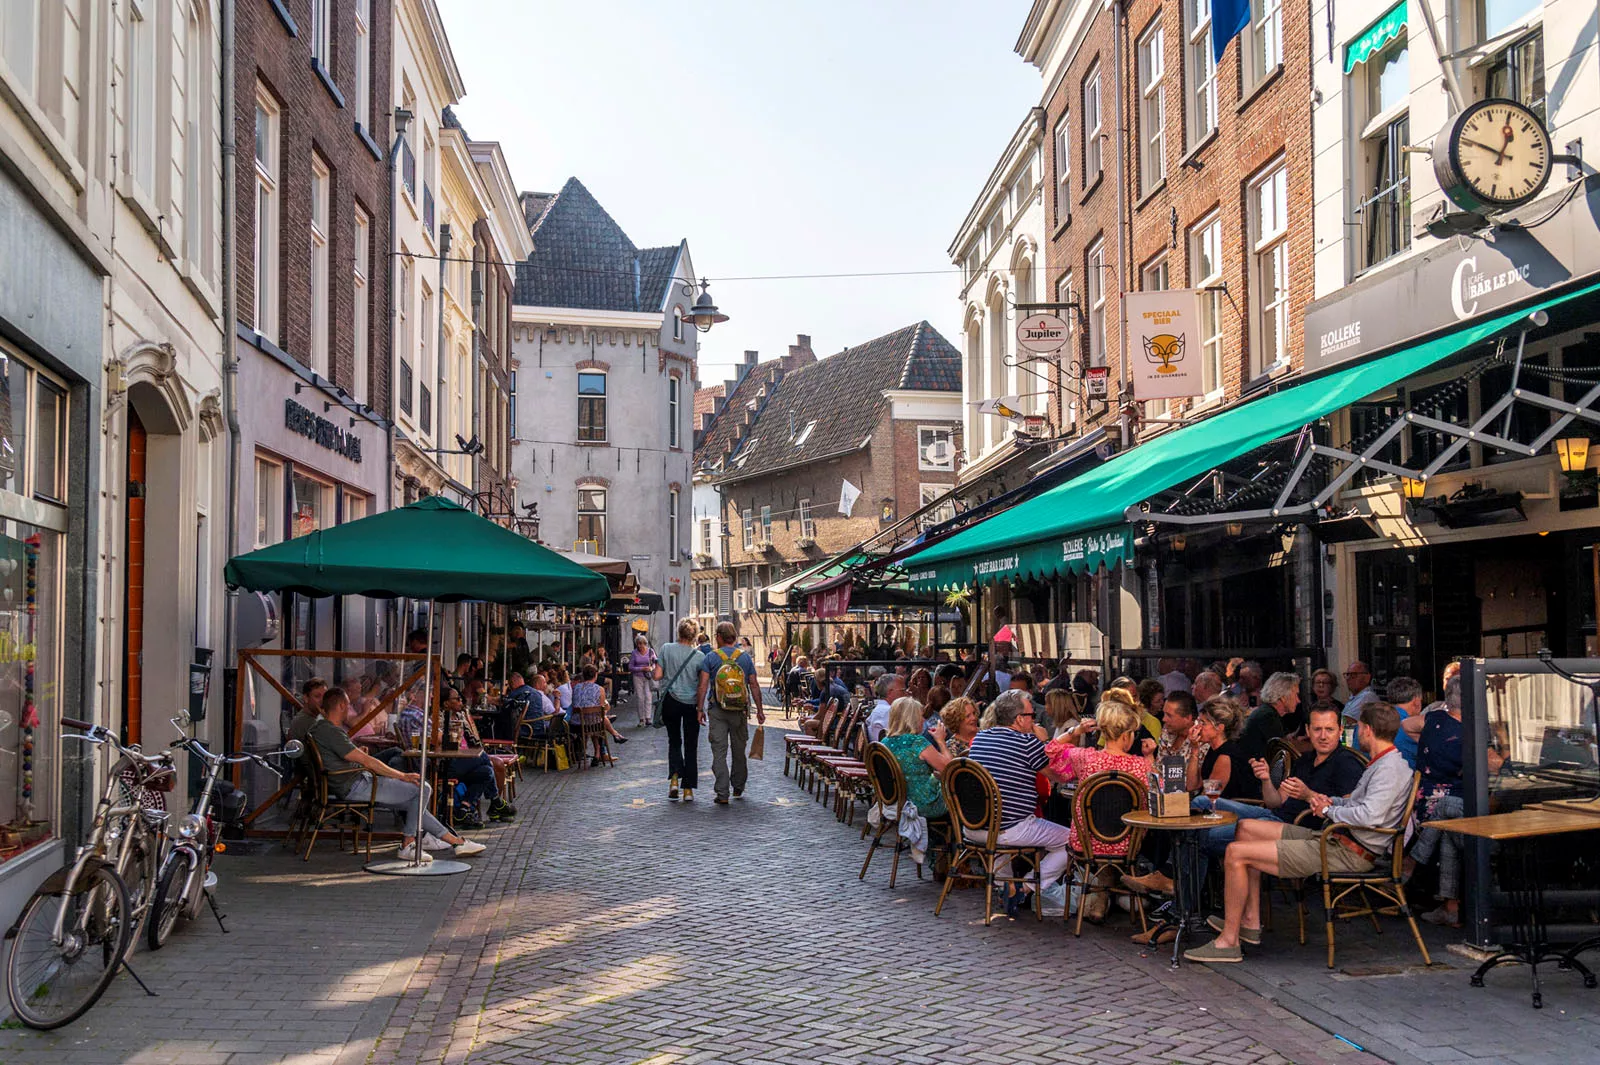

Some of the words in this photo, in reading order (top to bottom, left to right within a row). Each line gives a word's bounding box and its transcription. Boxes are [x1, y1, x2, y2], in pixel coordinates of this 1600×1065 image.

[1469, 279, 1492, 300] BAR
[1493, 272, 1507, 291] LE
[1507, 263, 1530, 285] DUC
[1142, 309, 1181, 319] SPECIAAL
[1153, 317, 1171, 325] BIER
[1025, 329, 1062, 340] Jupiler
[1320, 320, 1361, 349] KOLLEKE
[1087, 370, 1106, 378] Duvel
[988, 559, 999, 573] BAR
[1003, 556, 1014, 571] DUC
